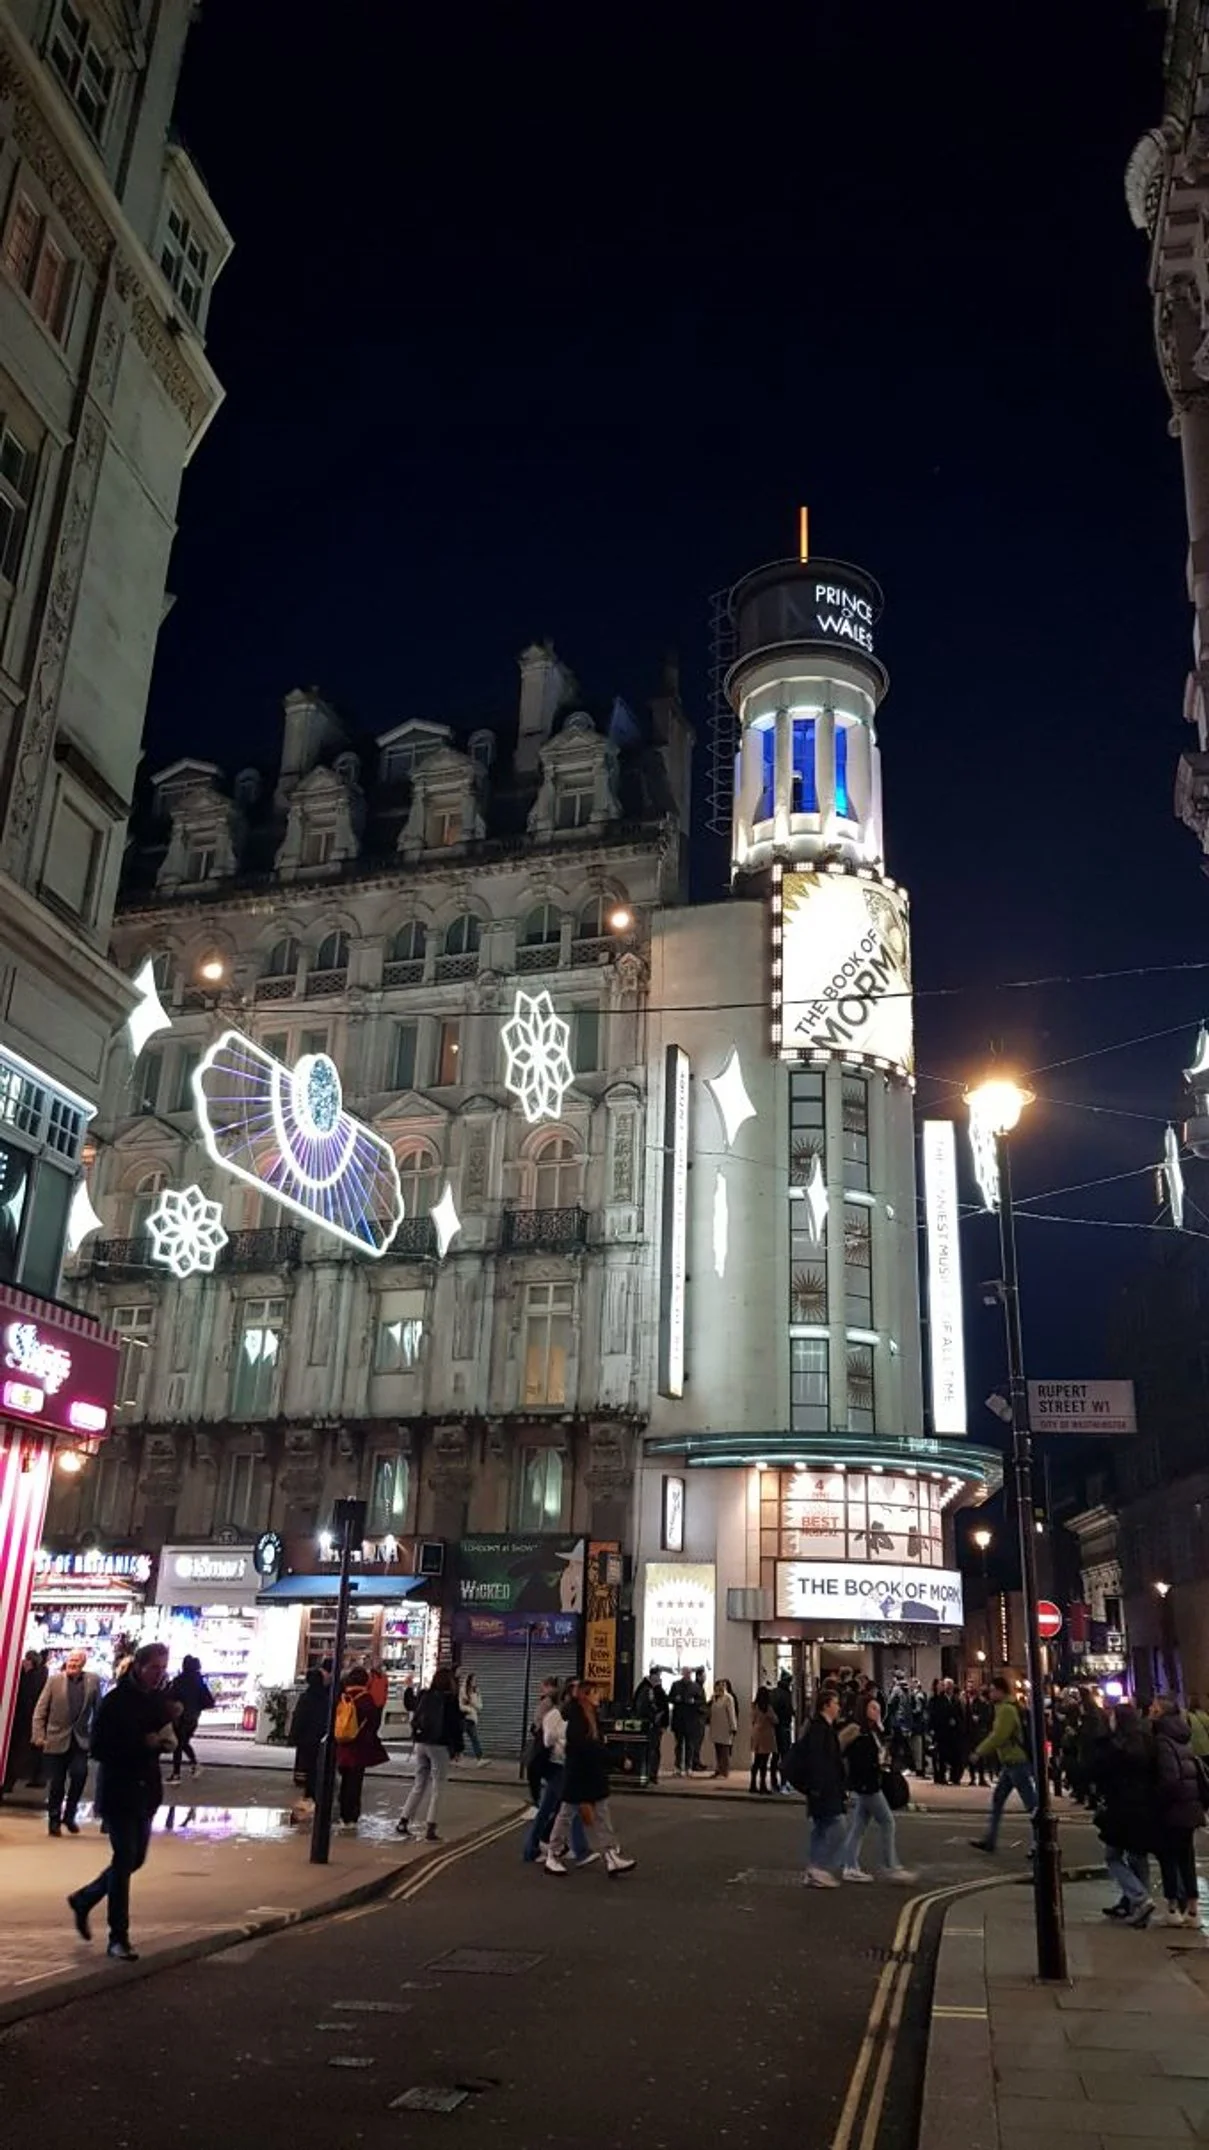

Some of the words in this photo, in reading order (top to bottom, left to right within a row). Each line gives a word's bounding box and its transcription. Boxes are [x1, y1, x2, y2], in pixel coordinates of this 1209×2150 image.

[815, 584, 872, 626] PRINCE
[816, 614, 874, 652] WALES
[794, 1000, 829, 1035] THE
[823, 952, 865, 1001] BOOK
[860, 928, 879, 954] OF
[1038, 1385, 1088, 1398] RUPERT
[1039, 1400, 1086, 1413] STREET
[1092, 1401, 1111, 1413] W1
[814, 1479, 824, 1491] 4
[801, 1516, 839, 1529] BEST
[460, 1580, 510, 1600] WICKED
[798, 1578, 839, 1595] THE
[845, 1579, 901, 1598] BOOK
[905, 1582, 927, 1599] OF
[666, 1627, 682, 1637] I'M
[686, 1627, 694, 1637] A
